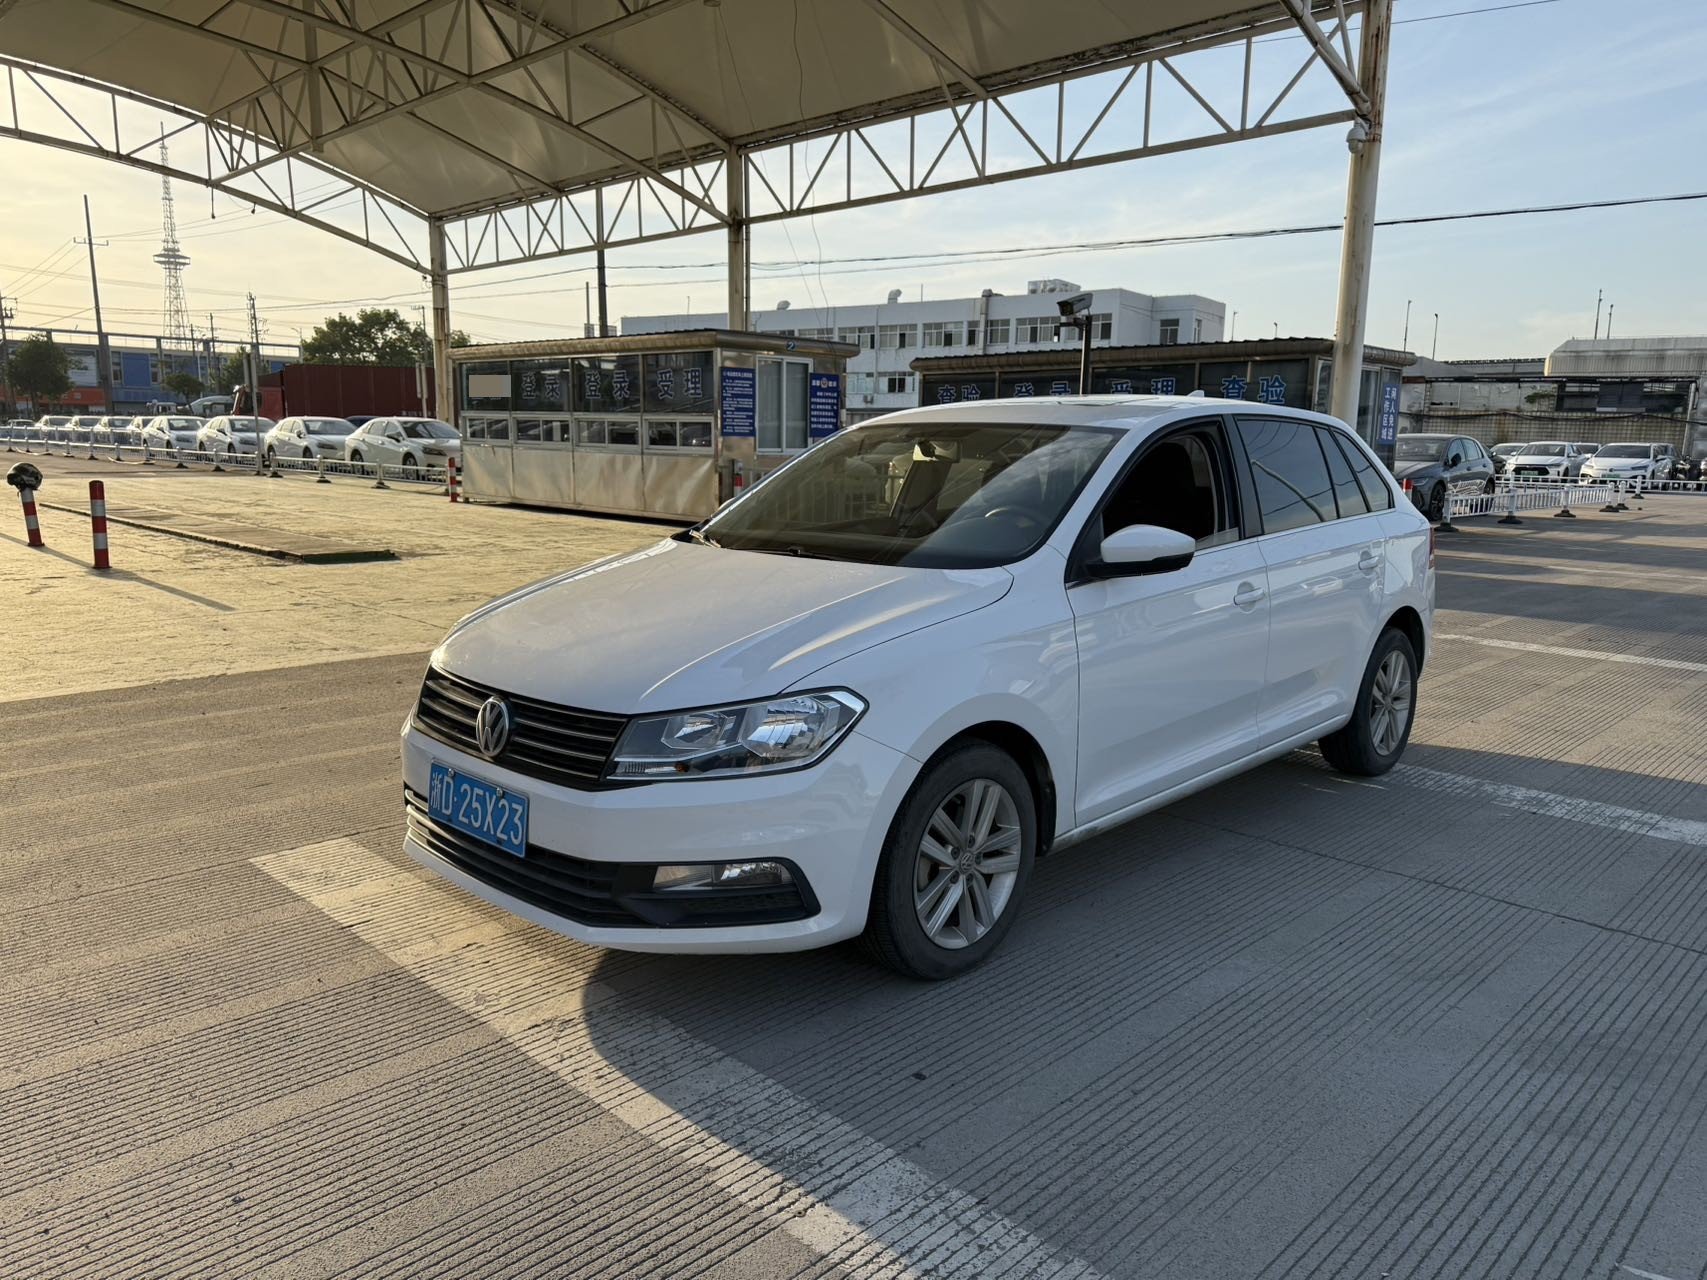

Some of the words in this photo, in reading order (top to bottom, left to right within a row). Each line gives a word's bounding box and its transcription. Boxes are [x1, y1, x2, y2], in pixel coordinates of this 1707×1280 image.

[786, 341, 795, 351] 2
[521, 372, 560, 400] 登录
[585, 369, 630, 400] 登录
[657, 368, 703, 400] 受理
[937, 383, 981, 404] 查验
[1220, 374, 1287, 404] 查验
